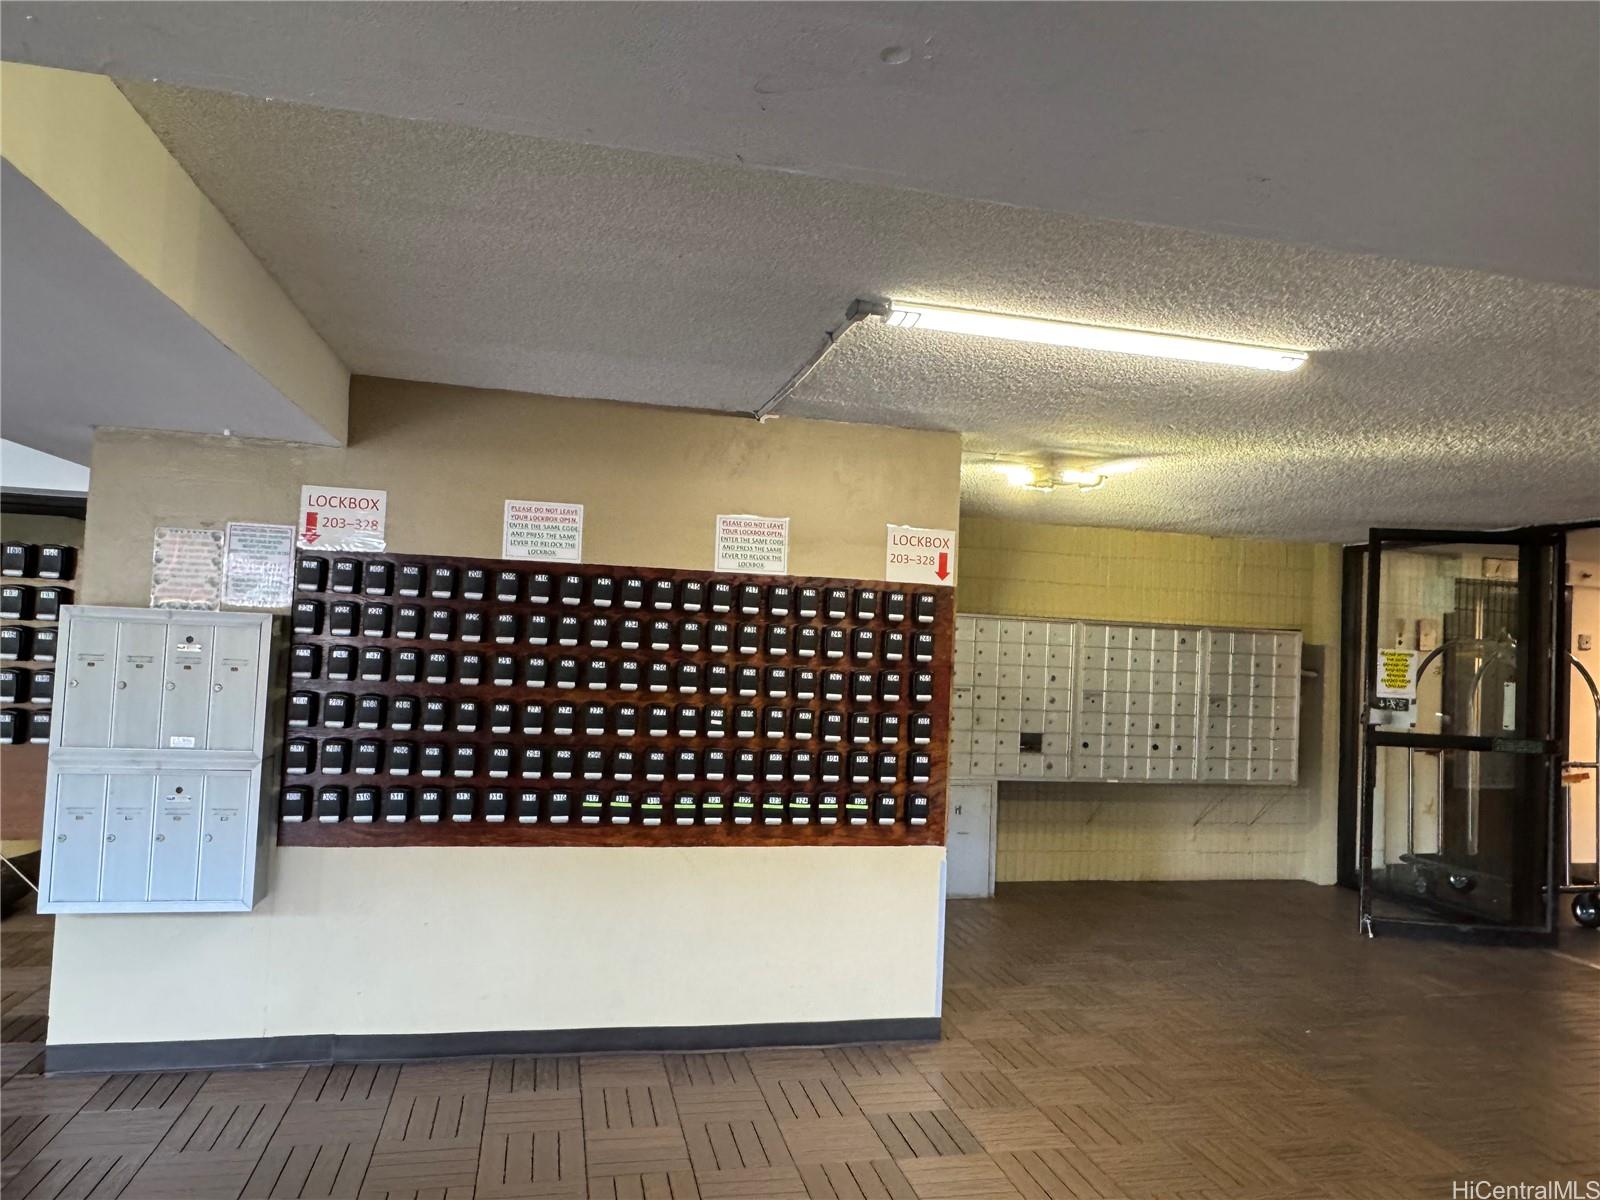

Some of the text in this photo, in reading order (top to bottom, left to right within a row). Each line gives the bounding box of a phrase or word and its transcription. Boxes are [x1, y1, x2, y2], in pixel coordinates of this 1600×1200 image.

[308, 494, 380, 511] LOCKBOX
[322, 517, 379, 530] 203-328
[893, 534, 950, 549] LOCKBOX
[890, 553, 935, 565] 203-328
